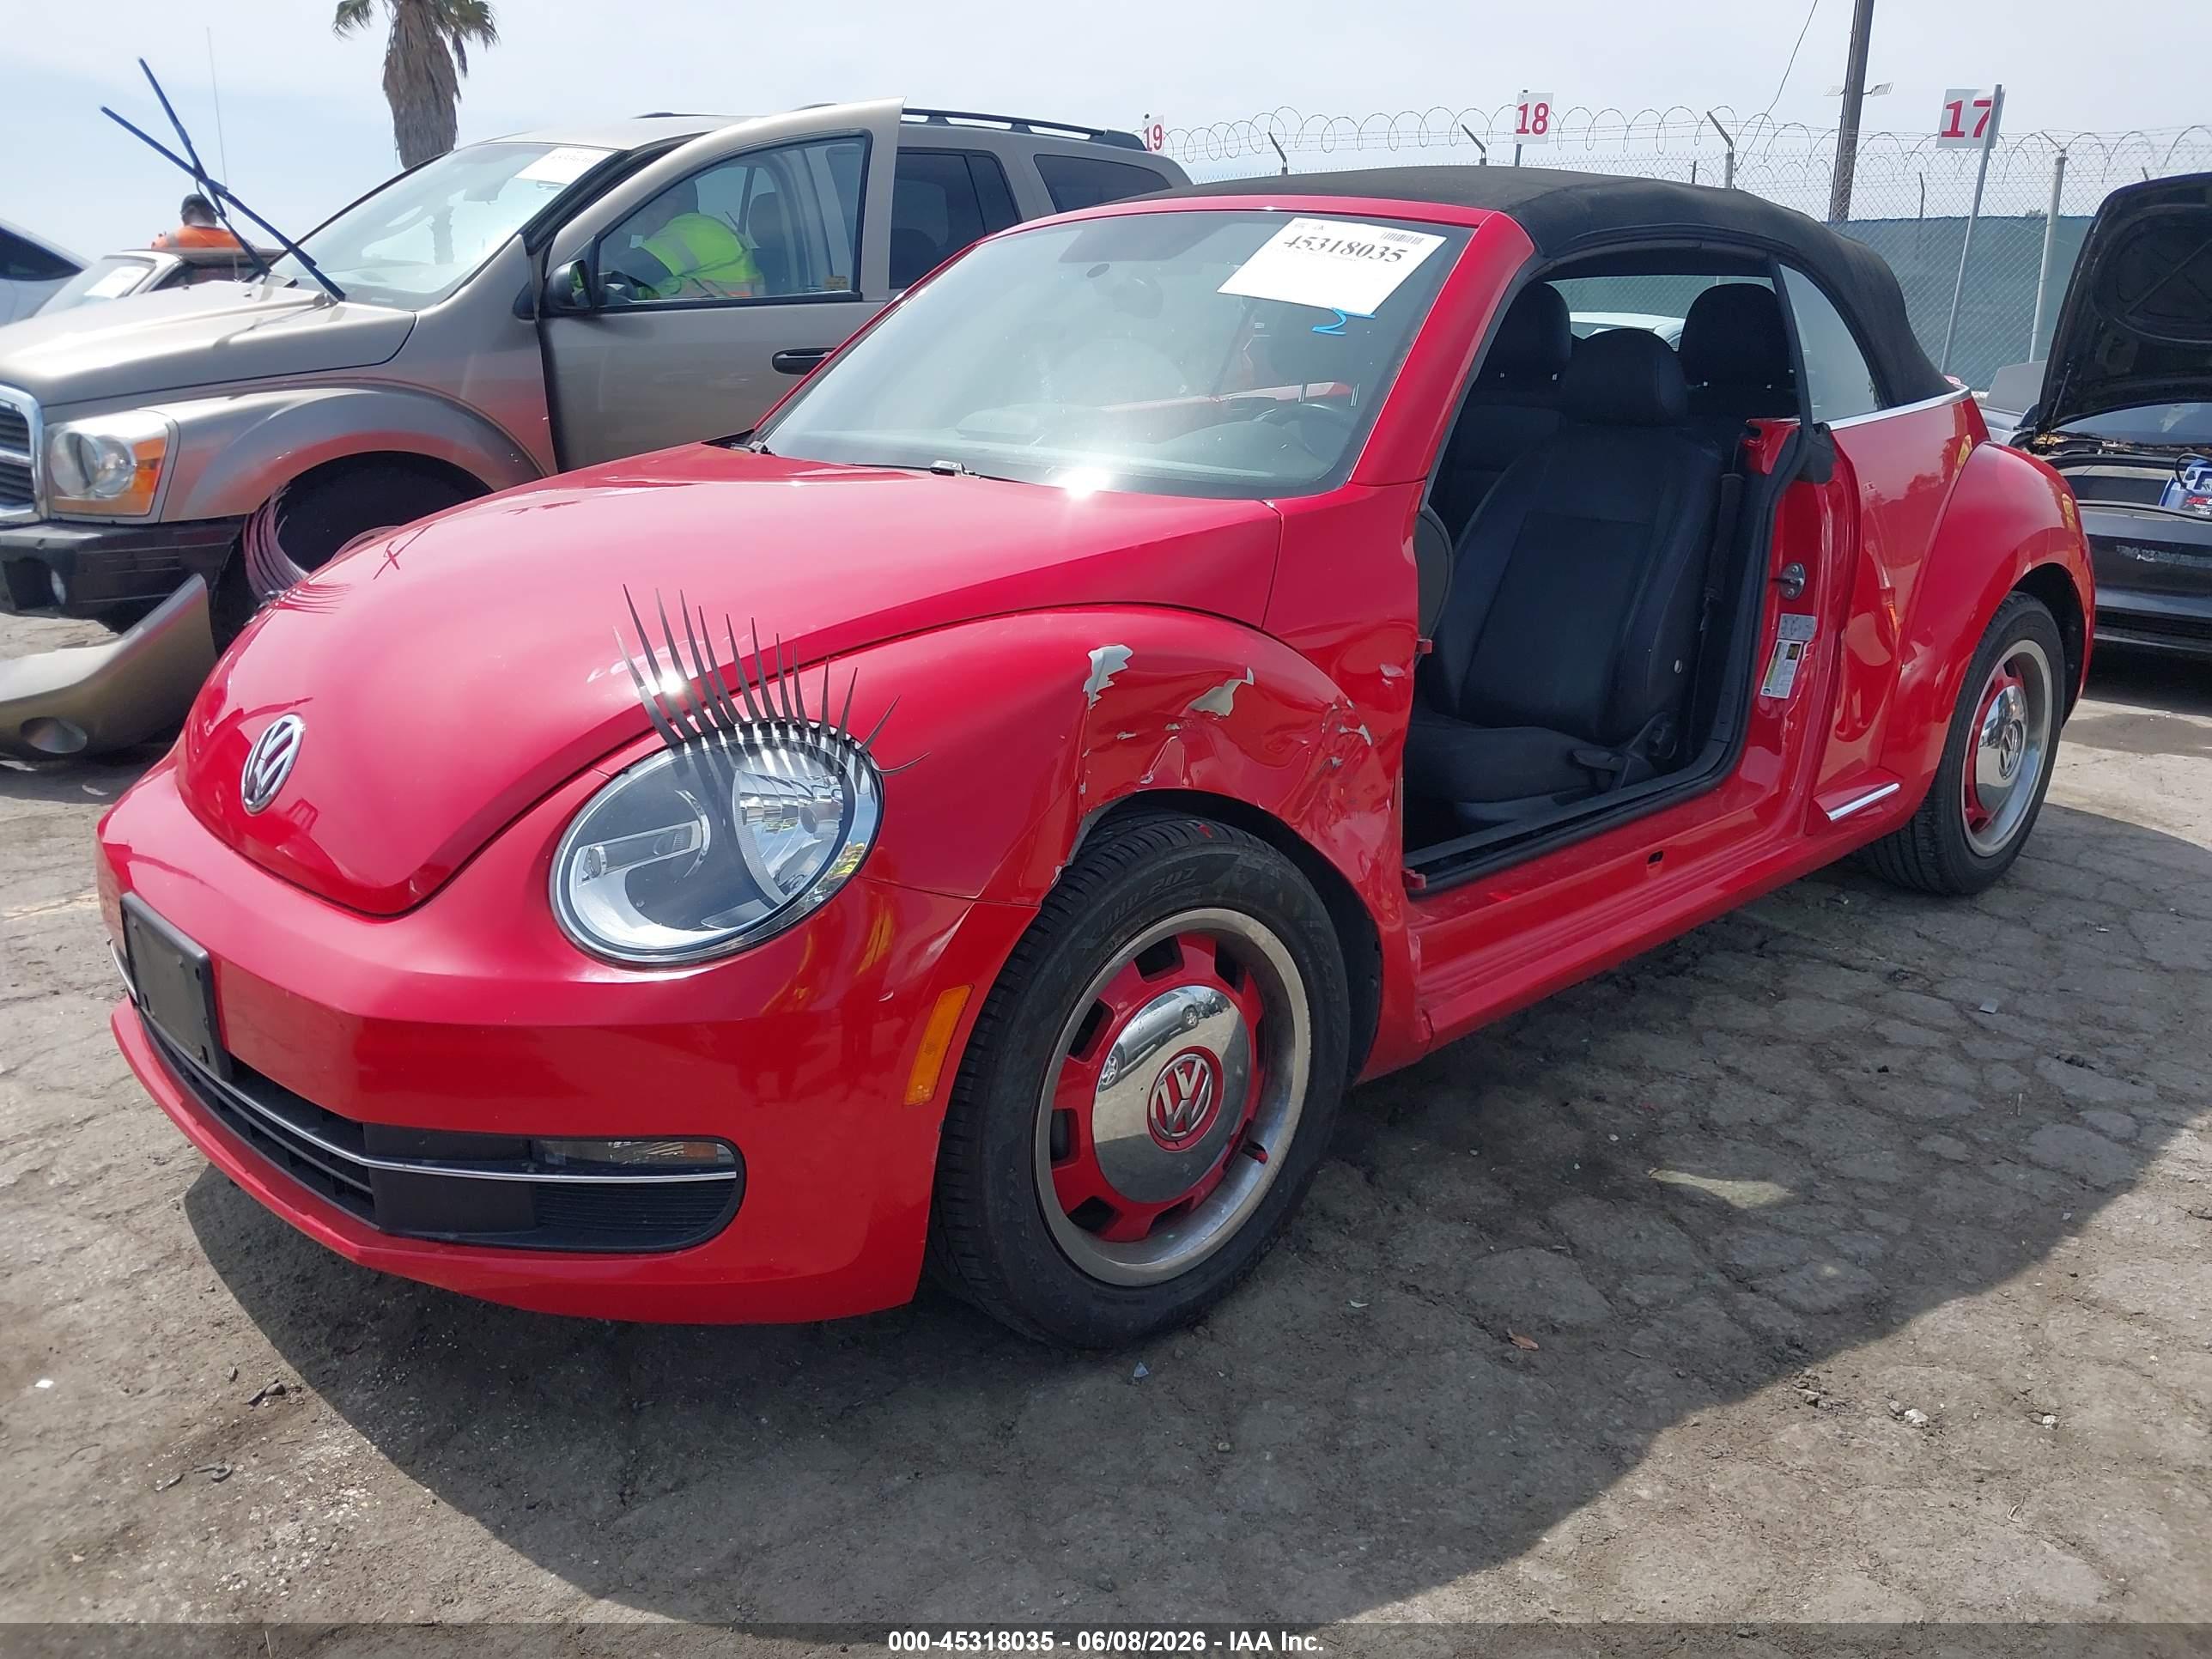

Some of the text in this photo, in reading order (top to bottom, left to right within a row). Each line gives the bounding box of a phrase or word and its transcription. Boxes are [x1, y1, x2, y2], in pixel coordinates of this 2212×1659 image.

[1516, 102, 1549, 136] 18
[1941, 100, 1992, 138] 17
[1143, 124, 1163, 152] 19
[1283, 234, 1410, 264] 45318035
[1151, 1054, 1212, 1138] VW
